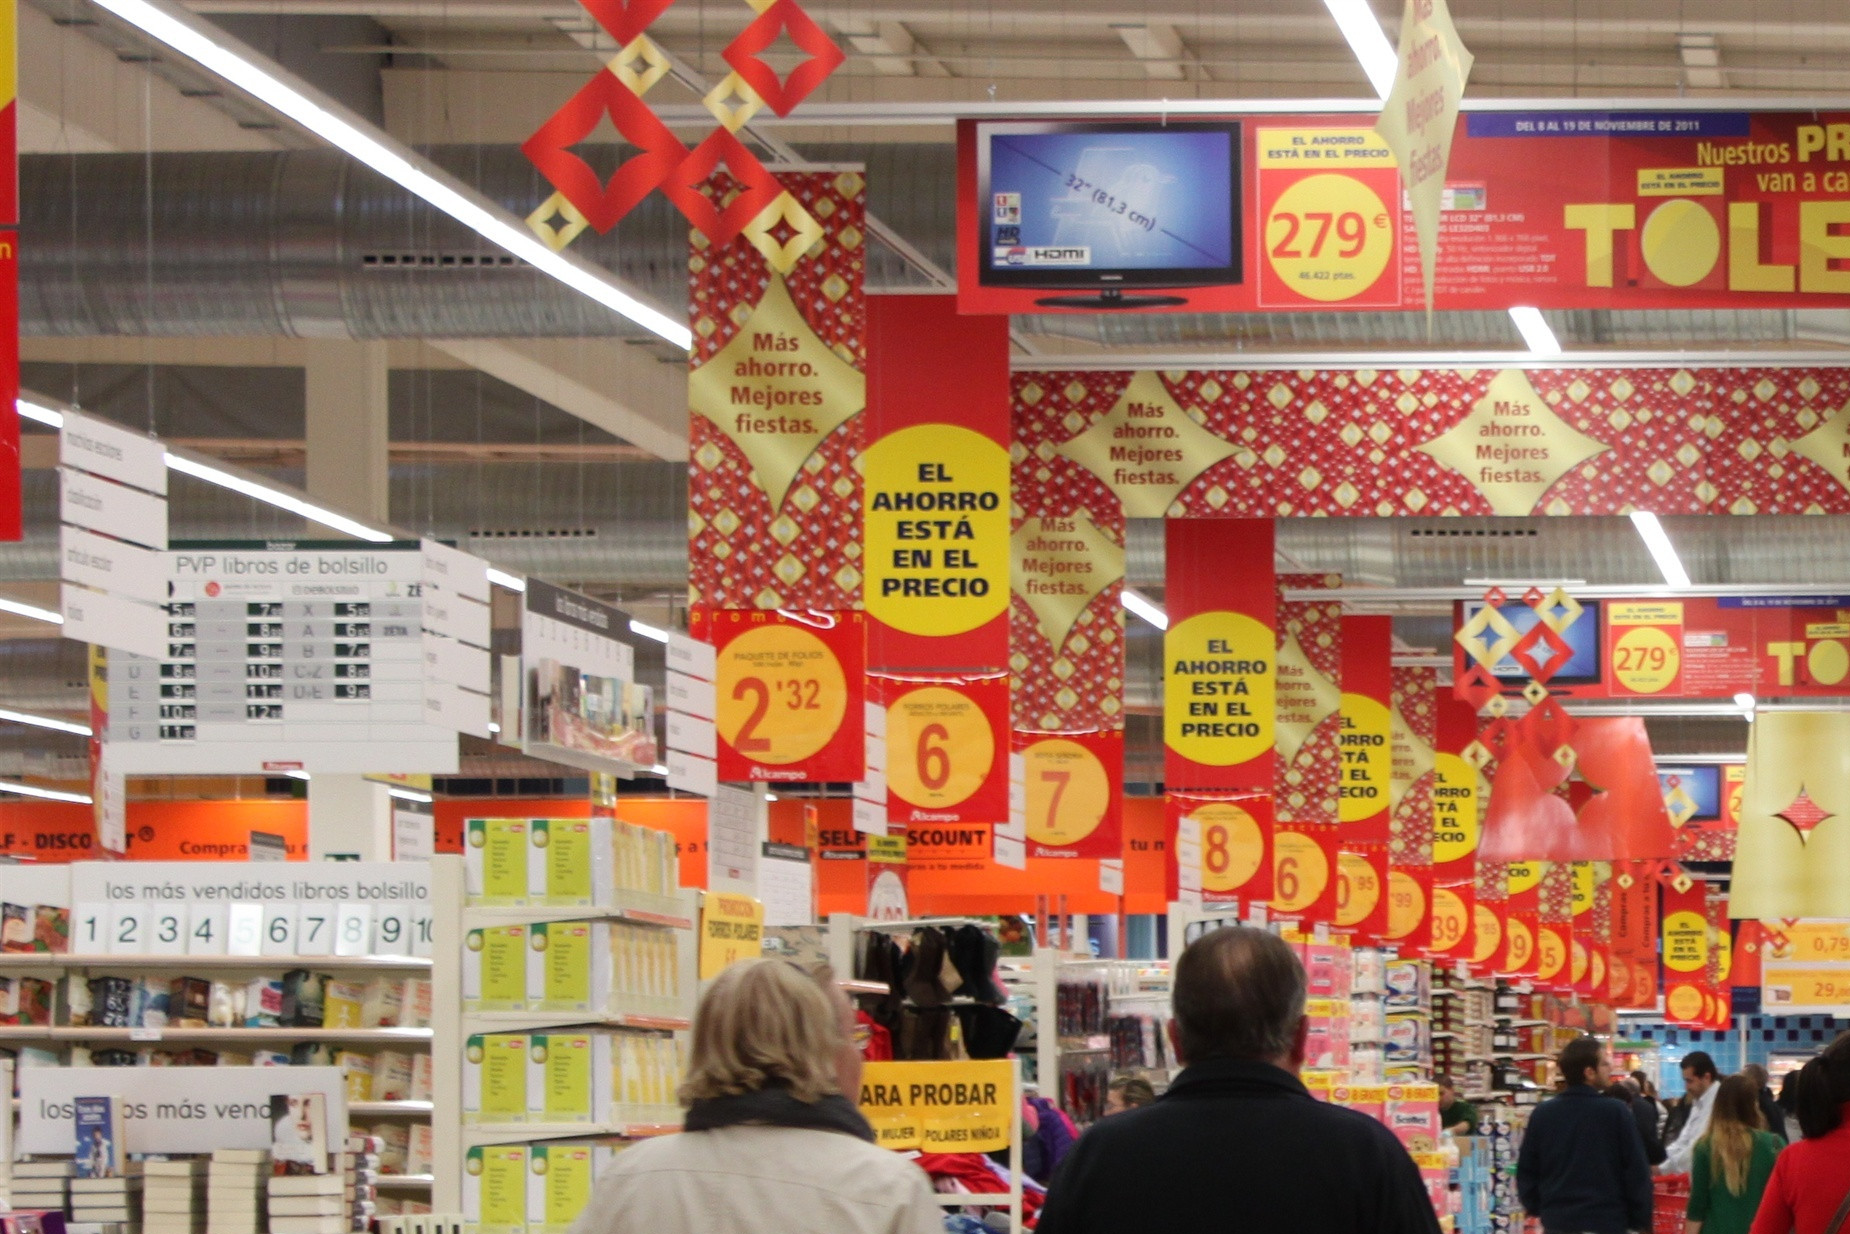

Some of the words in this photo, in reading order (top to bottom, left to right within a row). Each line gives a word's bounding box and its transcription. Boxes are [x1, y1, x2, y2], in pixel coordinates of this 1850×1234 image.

[1515, 121, 1536, 132] DEL
[1547, 121, 1560, 132] AL
[1563, 120, 1576, 132] 19
[1578, 120, 1591, 132] DE
[1594, 120, 1656, 132] NOVIEMBRE
[1658, 120, 1674, 132] DE
[1676, 119, 1700, 132] 2011
[1310, 135, 1365, 146] AHORRO
[1304, 148, 1321, 159] EN
[1344, 148, 1390, 159] PRECIO
[1697, 140, 1790, 168] Nuestros
[1757, 172, 1794, 192] van
[1803, 174, 1816, 192] a
[1271, 212, 1367, 260] 279
[752, 332, 799, 353] Más
[734, 357, 818, 379] ahorro.
[730, 385, 823, 409] Mejores
[1127, 401, 1164, 419] Más
[1494, 400, 1530, 417] Más
[735, 413, 818, 435] fiestas.
[1113, 421, 1179, 440] ahorro.
[1479, 421, 1546, 438] ahorro.
[1109, 444, 1183, 466] Mejores
[1475, 443, 1549, 464] Mejores
[918, 463, 953, 483] EL
[1113, 466, 1180, 487] fiestas.
[1479, 465, 1546, 485] fiestas.
[871, 492, 999, 512] AHORRO
[896, 516, 975, 540] ESTÁ
[1026, 536, 1089, 552] ahorro.
[175, 556, 216, 574] PVP
[223, 555, 279, 574] libros
[286, 556, 311, 574] de
[318, 555, 389, 574] bolsillo
[892, 549, 934, 569] EN
[943, 548, 978, 568] EL
[1021, 557, 1093, 576] Mejores
[881, 577, 990, 598] PRECIO
[1026, 579, 1088, 596] fiestas.
[1207, 639, 1233, 654] EL
[1173, 660, 1268, 676] AHORRO
[1616, 646, 1666, 672] 279
[1191, 677, 1250, 696] ESTÁ
[731, 676, 821, 753] 2'32
[1189, 702, 1218, 717] EN
[1225, 702, 1252, 717] EL
[1180, 722, 1261, 738] PRECIO
[917, 723, 951, 790] 6
[750, 766, 807, 781] Alcampo
[1041, 770, 1071, 829] 7
[909, 809, 960, 823] Alcampo
[818, 830, 866, 847] SELF
[907, 830, 986, 847] SCOUNT
[1207, 825, 1229, 873] 8
[1277, 857, 1299, 901] 6
[105, 883, 136, 900] los
[143, 881, 186, 900] más
[193, 881, 286, 900] vendidos
[292, 881, 350, 900] libros
[356, 881, 428, 900] bolsillo
[84, 918, 98, 942] 1
[118, 918, 138, 942] 2
[158, 917, 179, 942] 3
[194, 918, 215, 942] 4
[268, 918, 288, 942] 6
[305, 917, 326, 942] 7
[380, 917, 401, 942] 9
[858, 1083, 903, 1107] ARA
[909, 1082, 998, 1107] PROBAR
[40, 1099, 74, 1120] los
[156, 1099, 207, 1120] más
